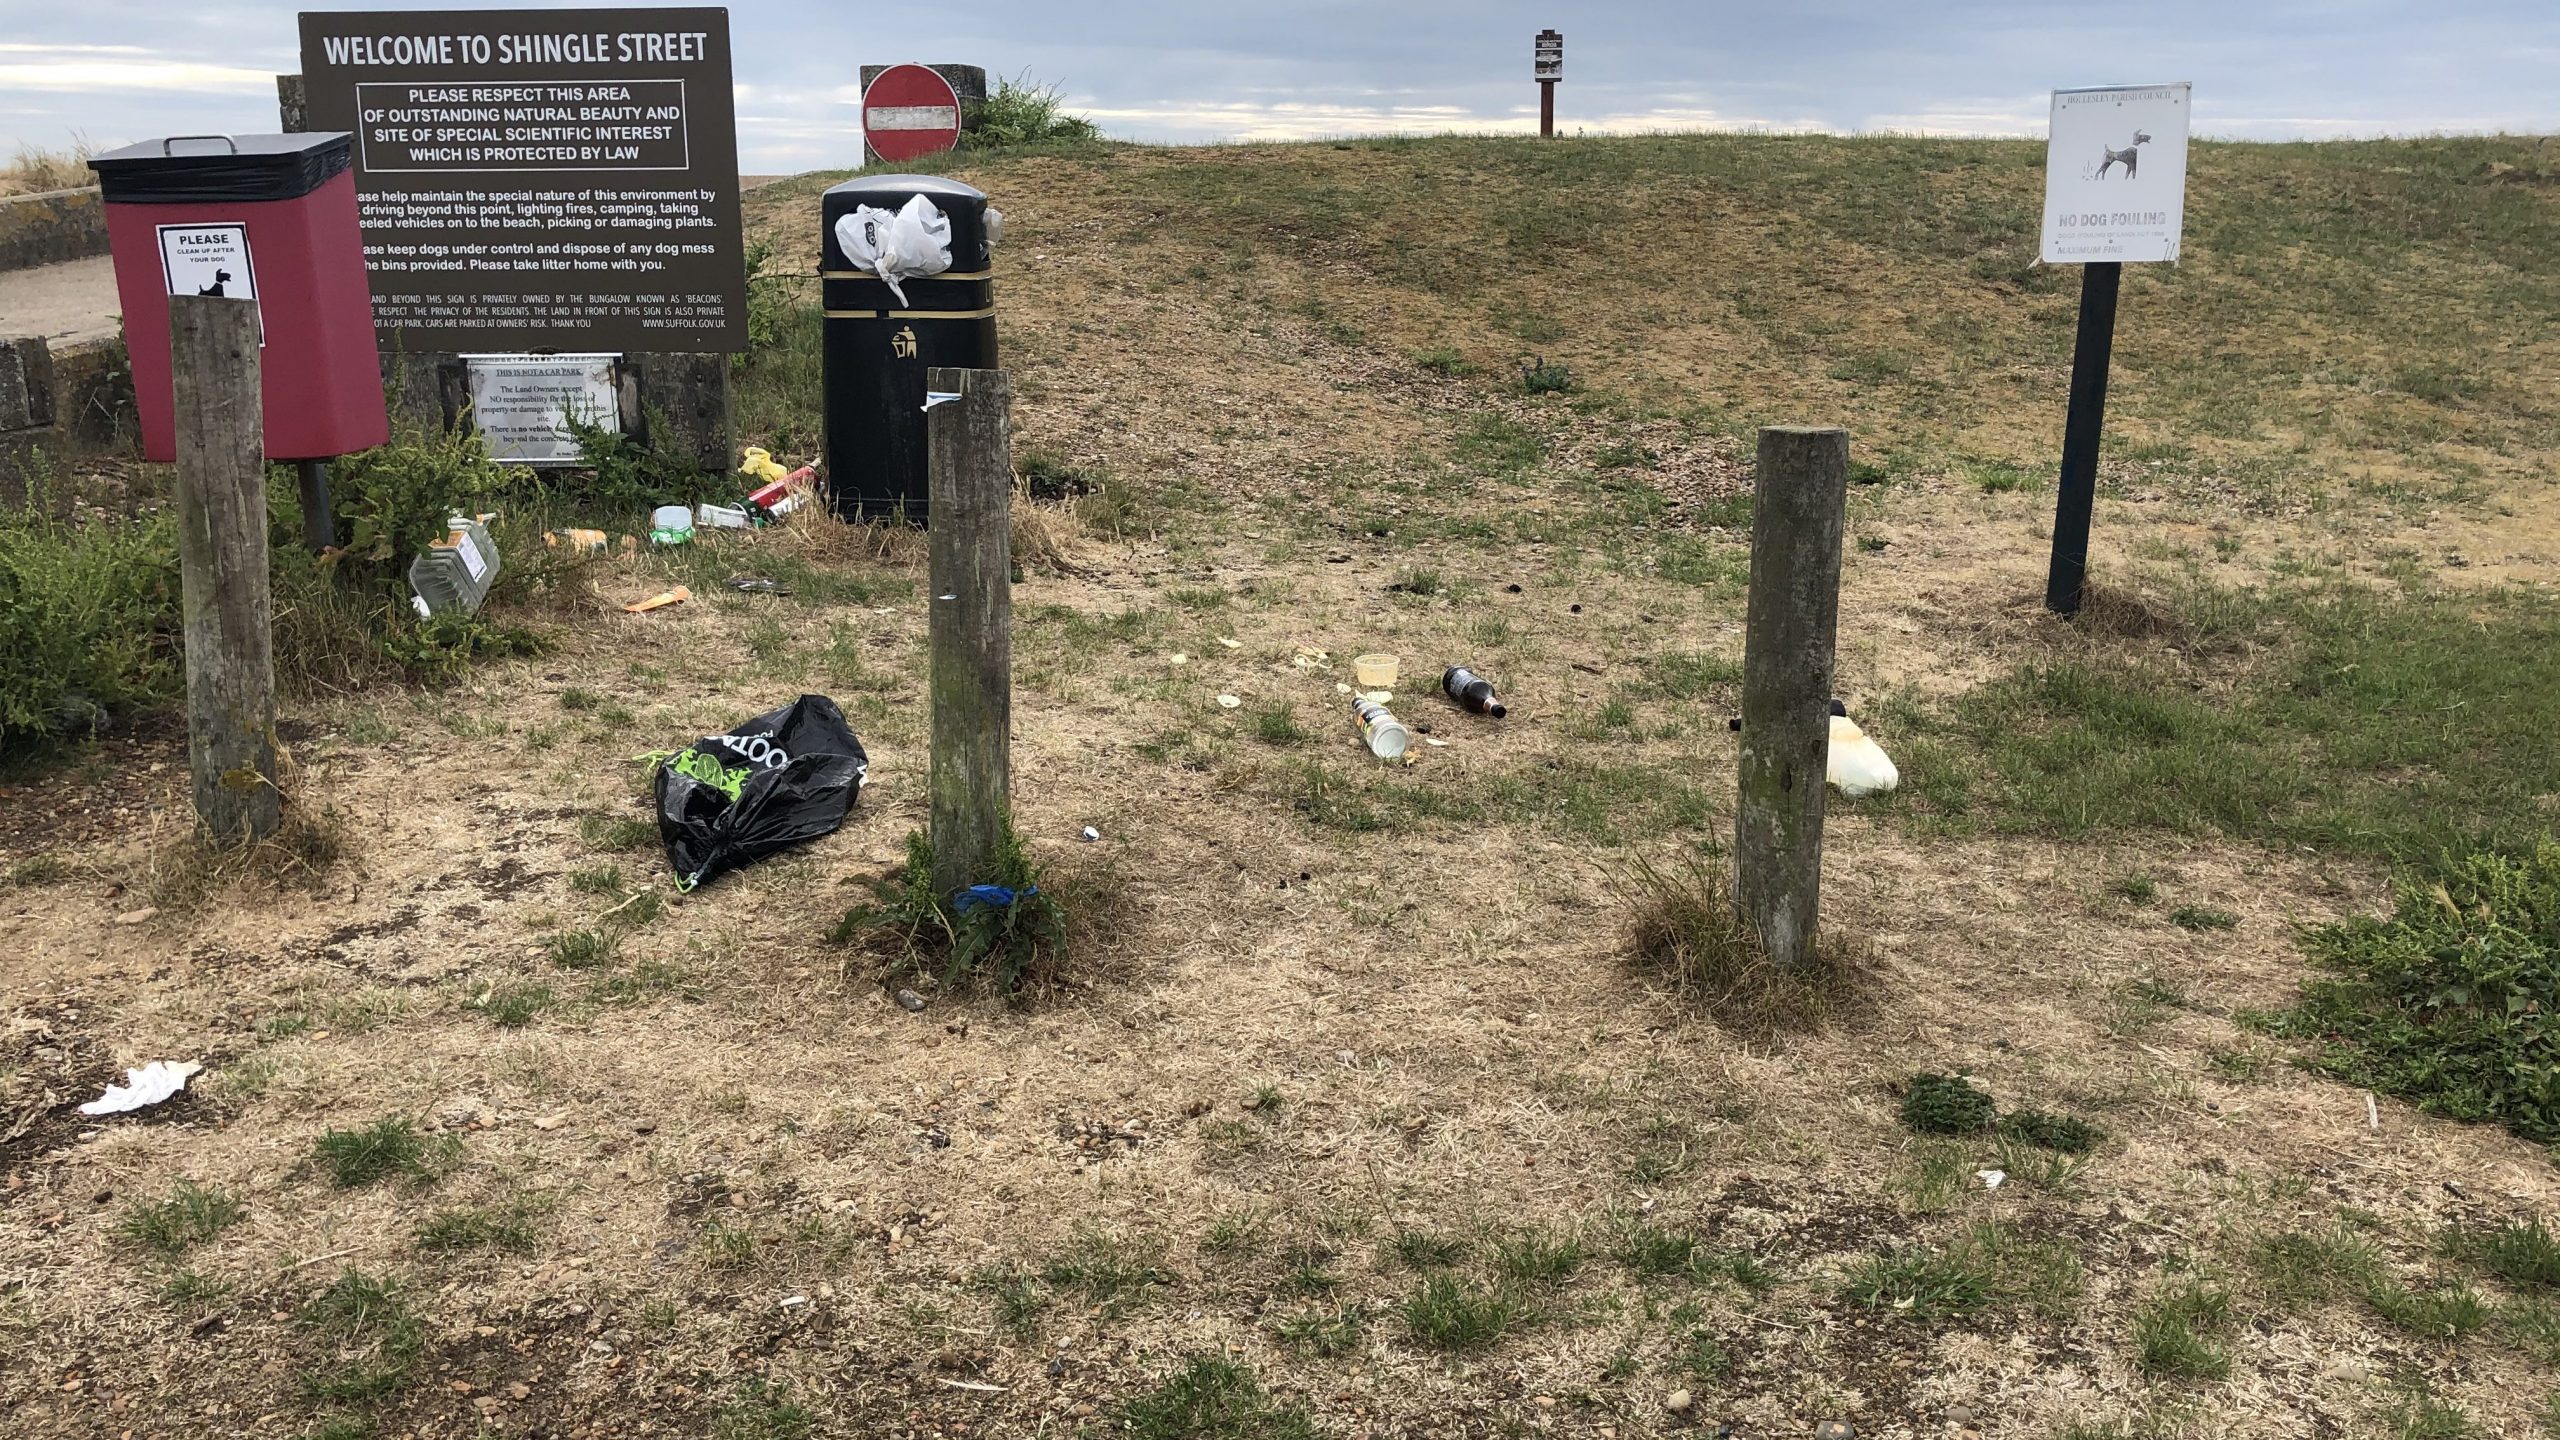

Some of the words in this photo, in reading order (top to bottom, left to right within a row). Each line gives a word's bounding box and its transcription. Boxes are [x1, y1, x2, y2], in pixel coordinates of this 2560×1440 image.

[324, 36, 453, 65] WELCOME
[457, 35, 490, 64] TO
[498, 34, 610, 64] SHINGLE
[618, 32, 706, 62] STREET
[410, 89, 468, 102] PLEASE
[472, 88, 543, 102] RESPECT
[547, 87, 583, 101] THIS
[588, 87, 630, 101] AREA
[364, 109, 384, 122] OF
[389, 108, 500, 123] OUTSTANDING
[504, 107, 576, 121] NATURAL
[580, 106, 641, 120] BEAUTY
[646, 106, 679, 120] AND
[375, 128, 408, 142] SITE
[412, 128, 432, 142] OF
[437, 128, 502, 142] SPECIAL
[506, 127, 591, 141] SCIENTIFIC
[596, 126, 672, 140] INTEREST
[410, 148, 462, 161] WHICH
[466, 148, 480, 161] IS
[484, 147, 576, 160] PROTECTED
[581, 146, 600, 160] BY
[605, 146, 638, 160] LAW
[358, 192, 379, 202] ase
[382, 190, 408, 205] help
[412, 190, 463, 205] maintain
[466, 190, 485, 204] the
[489, 190, 532, 204] special
[536, 190, 575, 204] nature
[578, 189, 590, 201] of
[595, 189, 617, 200] this
[620, 189, 698, 200] environment
[701, 188, 715, 202] by
[362, 204, 404, 217] driving
[407, 204, 451, 217] beyond
[455, 204, 476, 214] this
[480, 204, 514, 217] point,
[518, 203, 562, 216] lighting
[566, 203, 596, 216] fires,
[600, 203, 656, 216] camping,
[660, 202, 698, 215] taking
[359, 217, 392, 228] eeled
[395, 217, 444, 228] vehicles
[448, 219, 462, 228] on
[466, 217, 477, 228] to
[480, 217, 499, 228] the
[503, 216, 544, 229] beach,
[548, 216, 591, 230] picking
[595, 218, 608, 227] or
[611, 215, 672, 230] damaging
[676, 215, 716, 229] plants.
[2060, 214, 2076, 227] NO
[2081, 213, 2106, 227] DOG
[2111, 212, 2165, 226] FOULING
[180, 234, 229, 245] PLEASE
[363, 246, 384, 255] ase
[388, 244, 416, 257] keep
[420, 243, 449, 257] dogs
[452, 243, 487, 254] under
[491, 243, 533, 254] control
[537, 243, 559, 254] and
[563, 243, 610, 256] dispose
[614, 242, 625, 254] of
[630, 245, 652, 256] any
[655, 242, 678, 256] dog
[682, 245, 714, 254] mess
[365, 260, 378, 270] he
[382, 259, 407, 270] bins
[410, 259, 466, 272] provided.
[470, 259, 510, 270] Please
[514, 259, 539, 270] take
[543, 259, 570, 270] litter
[574, 259, 607, 270] home
[611, 258, 636, 270] with
[640, 261, 665, 272] you.
[371, 295, 386, 304] AND
[392, 295, 420, 304] BEYOND
[426, 295, 441, 303] THIS
[448, 294, 464, 304] SIGN
[470, 294, 477, 304] IS
[483, 294, 517, 303] PRIVATELY
[523, 294, 550, 303] OWNED
[556, 294, 564, 303] BY
[570, 294, 583, 303] THE
[590, 294, 630, 303] BUNGALOW
[636, 294, 664, 303] KNOWN
[671, 294, 679, 303] AS
[379, 307, 407, 316] RESPECT
[414, 307, 427, 316] THE
[431, 307, 459, 316] PRIVACY
[463, 307, 471, 316] OF
[475, 307, 488, 316] THE
[534, 307, 547, 315] THE
[551, 307, 570, 316] LAND
[574, 307, 581, 315] IN
[585, 306, 607, 316] FRONT
[611, 307, 620, 316] OF
[624, 306, 640, 316] THIS
[644, 306, 660, 316] SIGN
[665, 306, 671, 316] IS
[675, 306, 693, 316] ALSO
[697, 307, 724, 316] PRIVATE
[384, 319, 388, 328] A
[390, 319, 403, 328] CAR
[426, 319, 443, 328] CARS
[444, 319, 457, 328] ARE
[459, 319, 486, 328] PARKED
[487, 319, 494, 328] AT
[551, 319, 574, 327] THANK
[576, 319, 591, 327] YOU
[561, 368, 583, 376] PARK.
[503, 395, 547, 404] responsibility
[482, 406, 508, 414] property
[519, 405, 544, 413] damage
